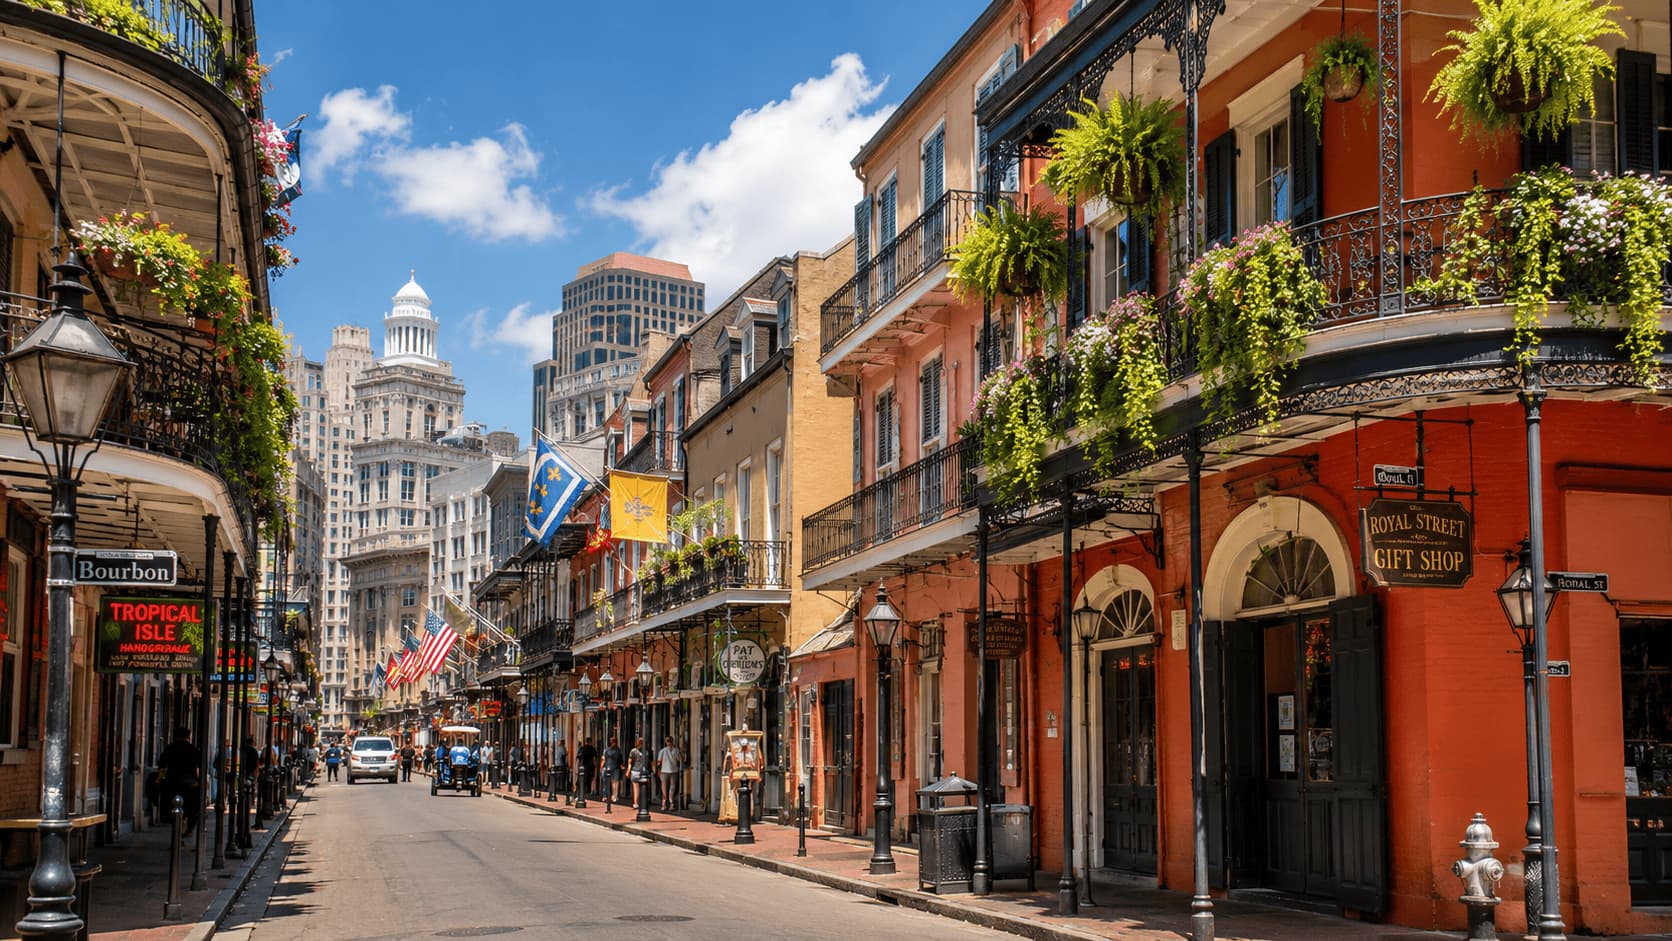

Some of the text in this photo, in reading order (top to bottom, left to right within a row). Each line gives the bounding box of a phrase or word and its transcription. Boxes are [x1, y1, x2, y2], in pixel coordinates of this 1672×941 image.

[1370, 513, 1466, 538] ROYAL STREET
[1374, 548, 1464, 571] GIFT SHOP
[79, 560, 169, 580] Bourbon
[110, 603, 201, 623] TROPICAL
[135, 623, 177, 641] ISLE
[733, 645, 755, 655] PAT
